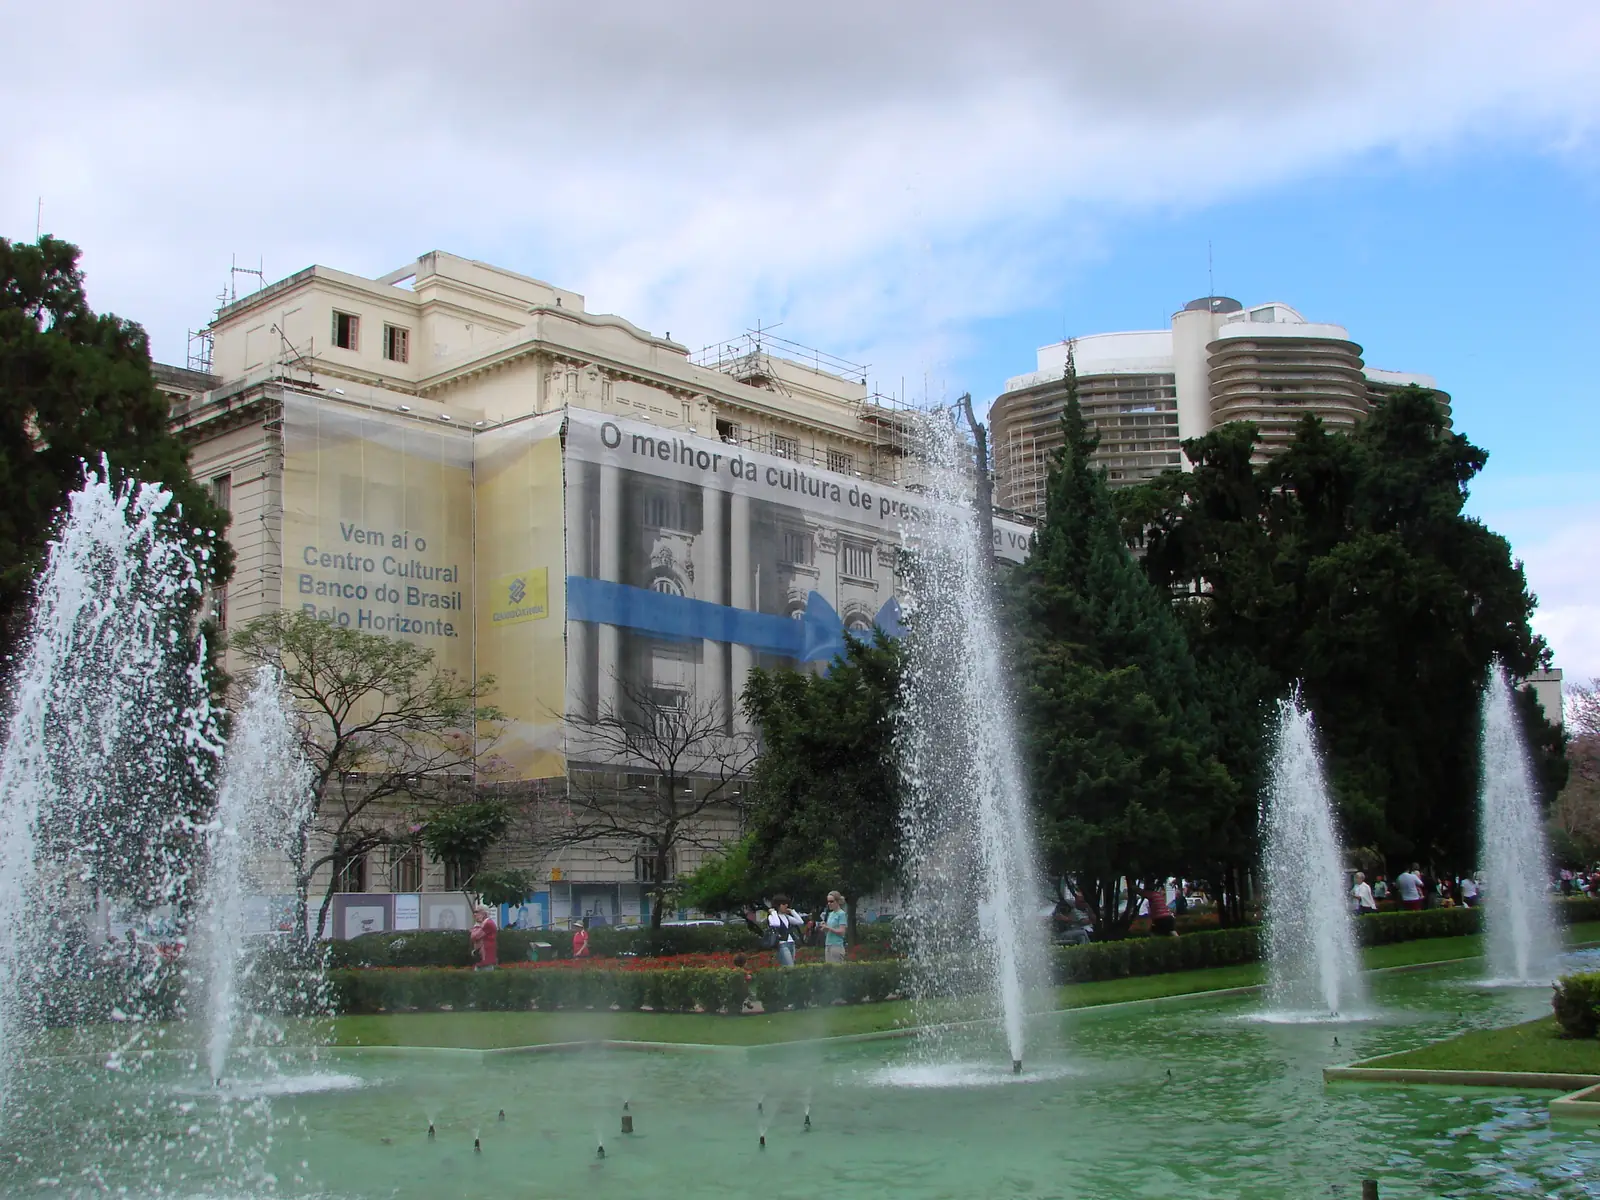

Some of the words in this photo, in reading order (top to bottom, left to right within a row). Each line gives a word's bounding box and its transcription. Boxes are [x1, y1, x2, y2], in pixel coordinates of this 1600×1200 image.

[600, 421, 621, 449] O
[632, 433, 722, 473] melhor
[729, 454, 757, 482] da
[765, 466, 841, 503] cultura
[848, 484, 872, 510] de
[339, 521, 385, 546] Vem
[391, 530, 408, 550] aí
[414, 537, 427, 552] o
[303, 545, 375, 573] Centro
[382, 555, 459, 584] Cultural
[298, 573, 368, 600] Banco
[374, 583, 400, 604] do
[406, 586, 462, 611] Brasil
[301, 602, 351, 627] Belo
[358, 608, 459, 638] Horizonte.
